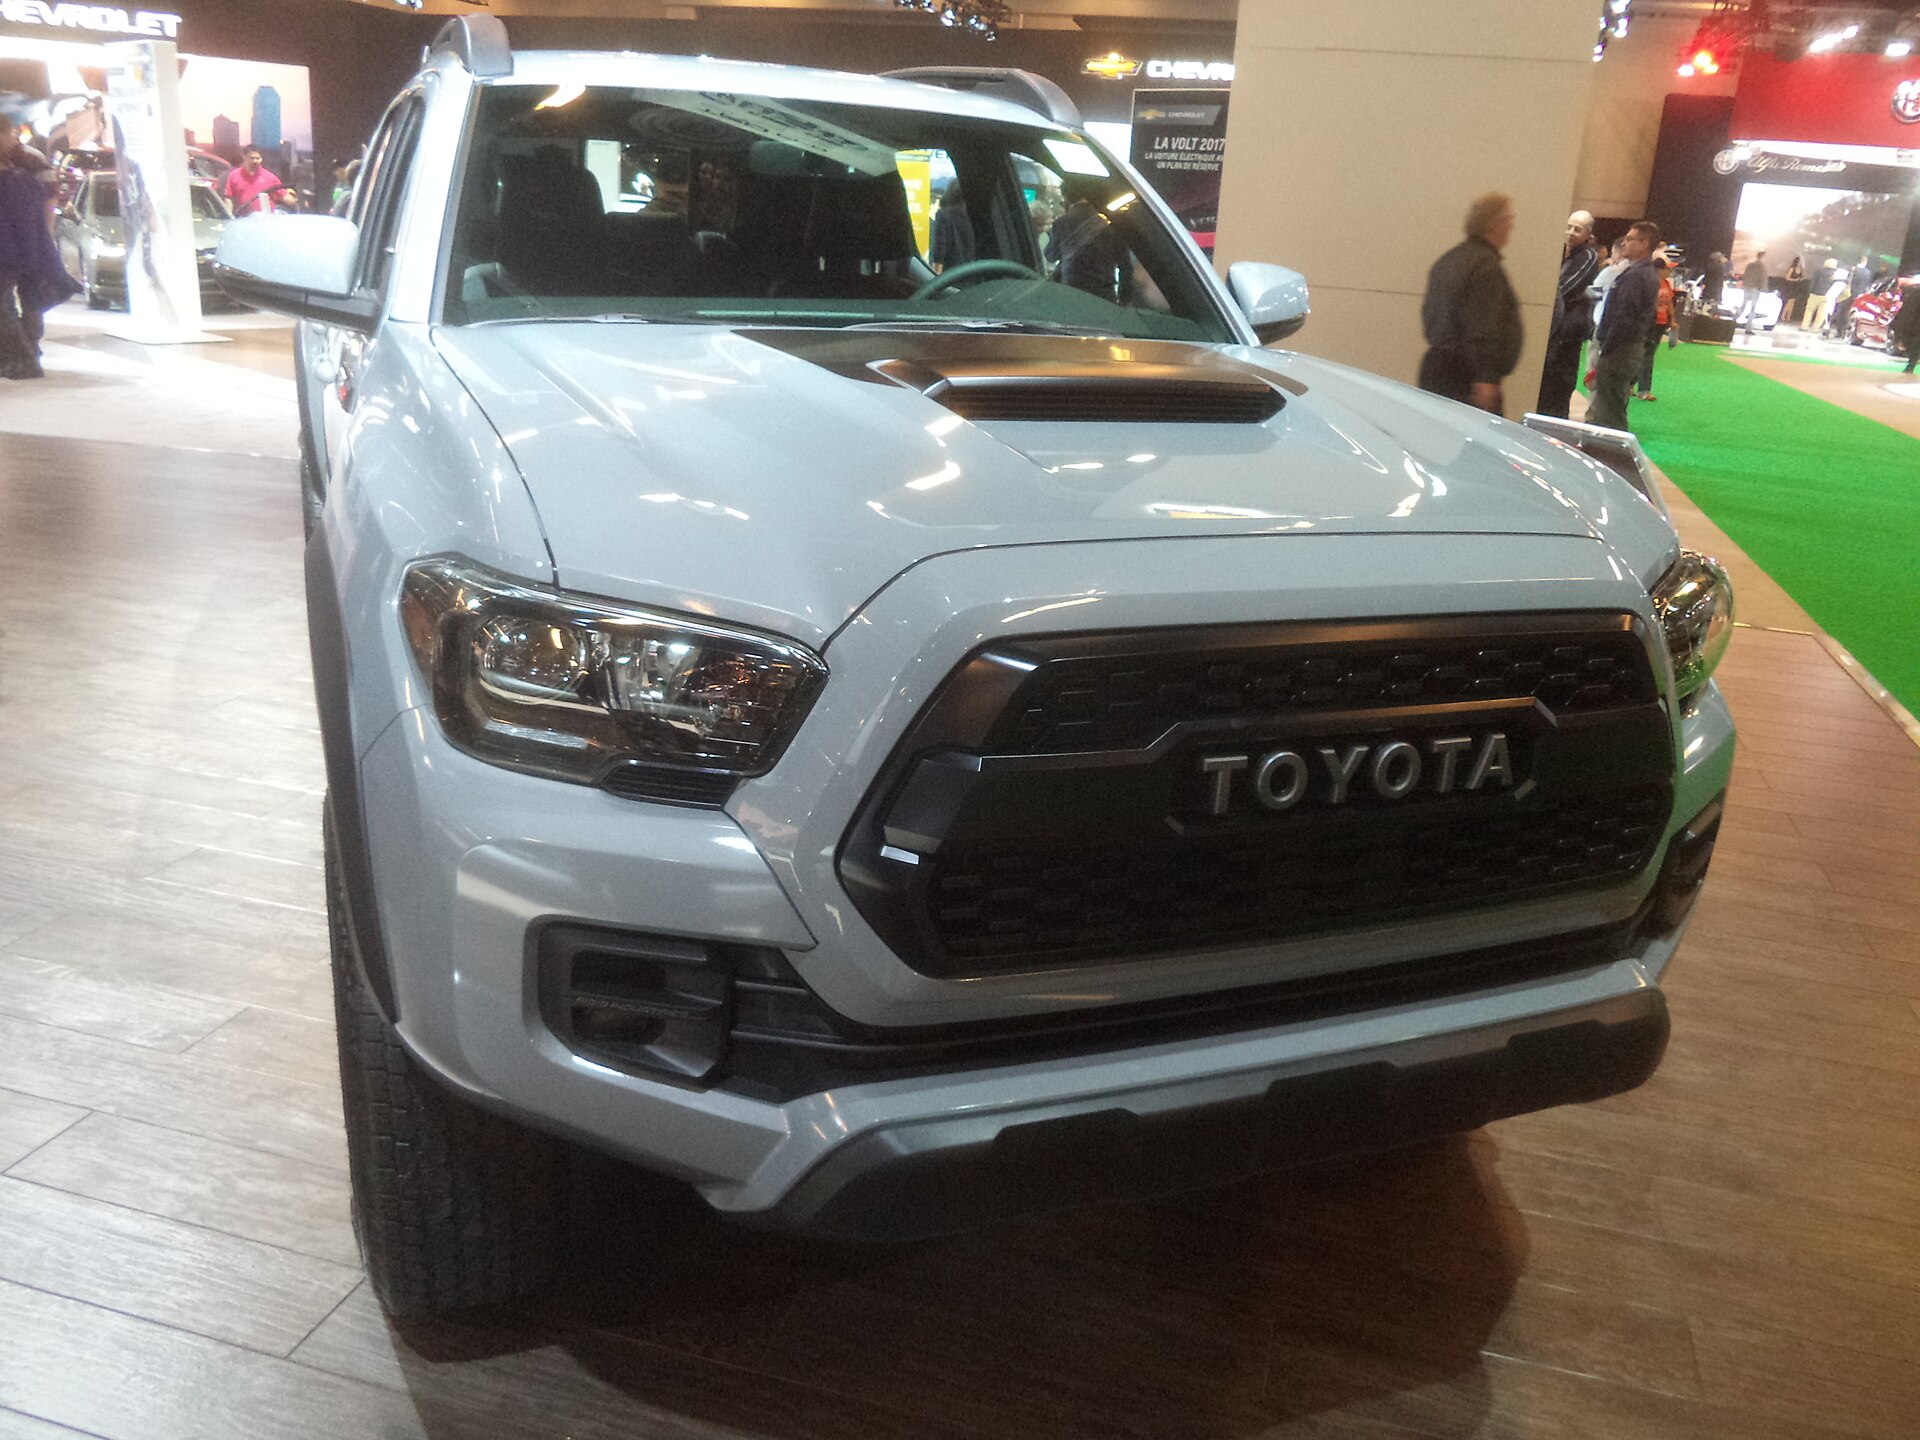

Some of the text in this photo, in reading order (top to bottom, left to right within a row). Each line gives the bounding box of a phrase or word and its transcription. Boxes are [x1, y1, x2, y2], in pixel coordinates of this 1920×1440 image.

[1155, 137, 1226, 151] LA VOLT 2017
[1154, 152, 1179, 160] VOITURE
[1183, 162, 1191, 170] DE
[1192, 162, 1219, 171] RÉSERVE
[1202, 733, 1514, 816] TOYOTA
